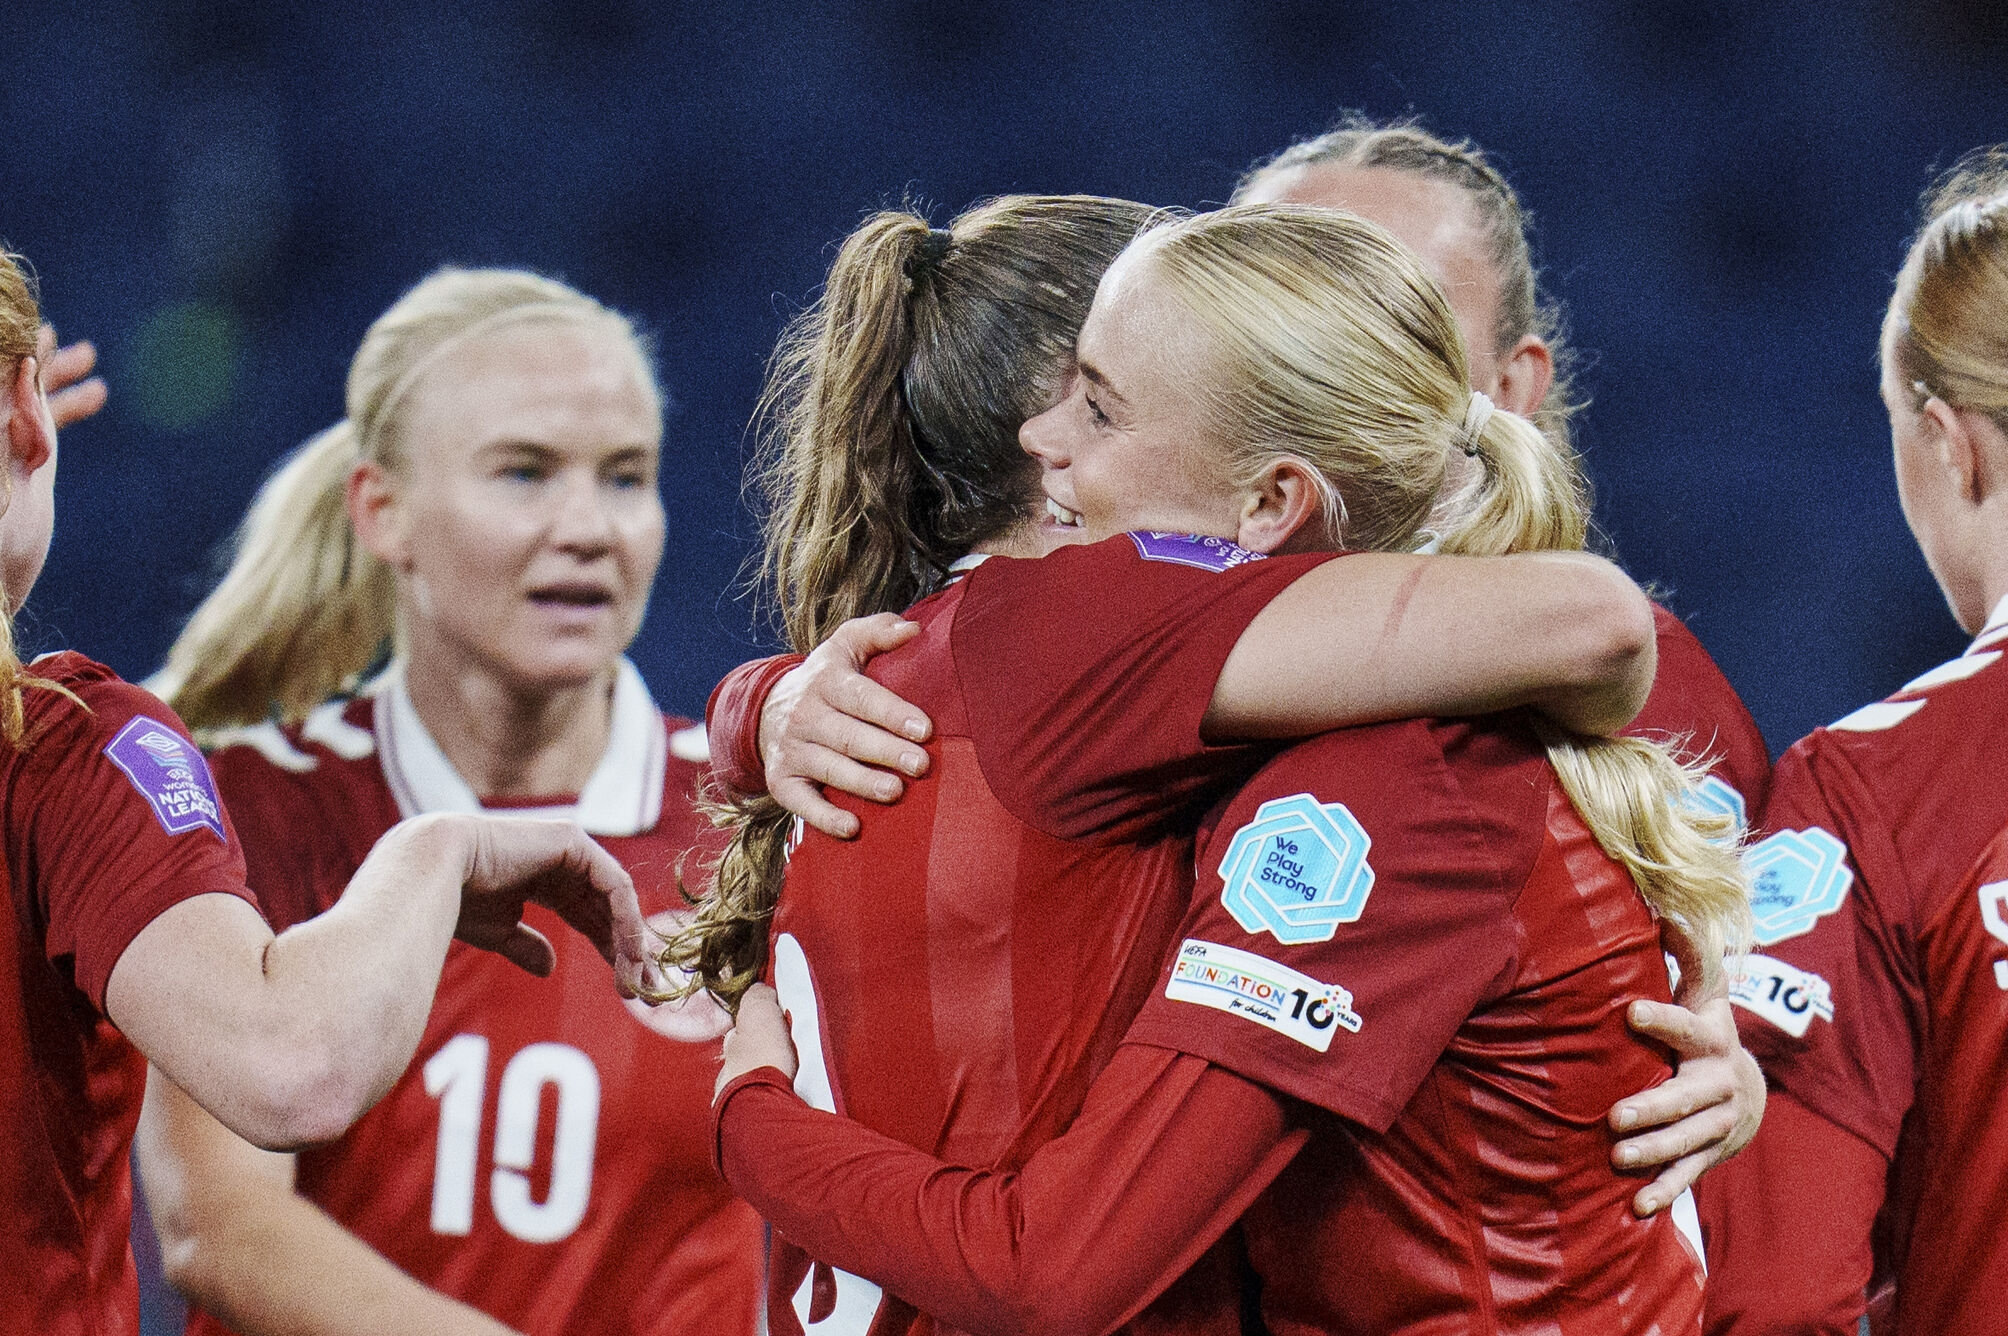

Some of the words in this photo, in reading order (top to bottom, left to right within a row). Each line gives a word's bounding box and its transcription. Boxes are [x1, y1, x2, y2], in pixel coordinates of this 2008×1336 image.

[1275, 836, 1299, 855] We
[1266, 851, 1304, 878] Play
[1260, 867, 1318, 901] Strong
[1184, 944, 1207, 957] UEFA
[1176, 961, 1286, 1006] FOUNDATION
[1768, 975, 1810, 1014] 10
[1228, 998, 1244, 1009] for
[1244, 1004, 1277, 1022] children
[1290, 988, 1335, 1030] 10
[423, 1032, 601, 1244] 10
